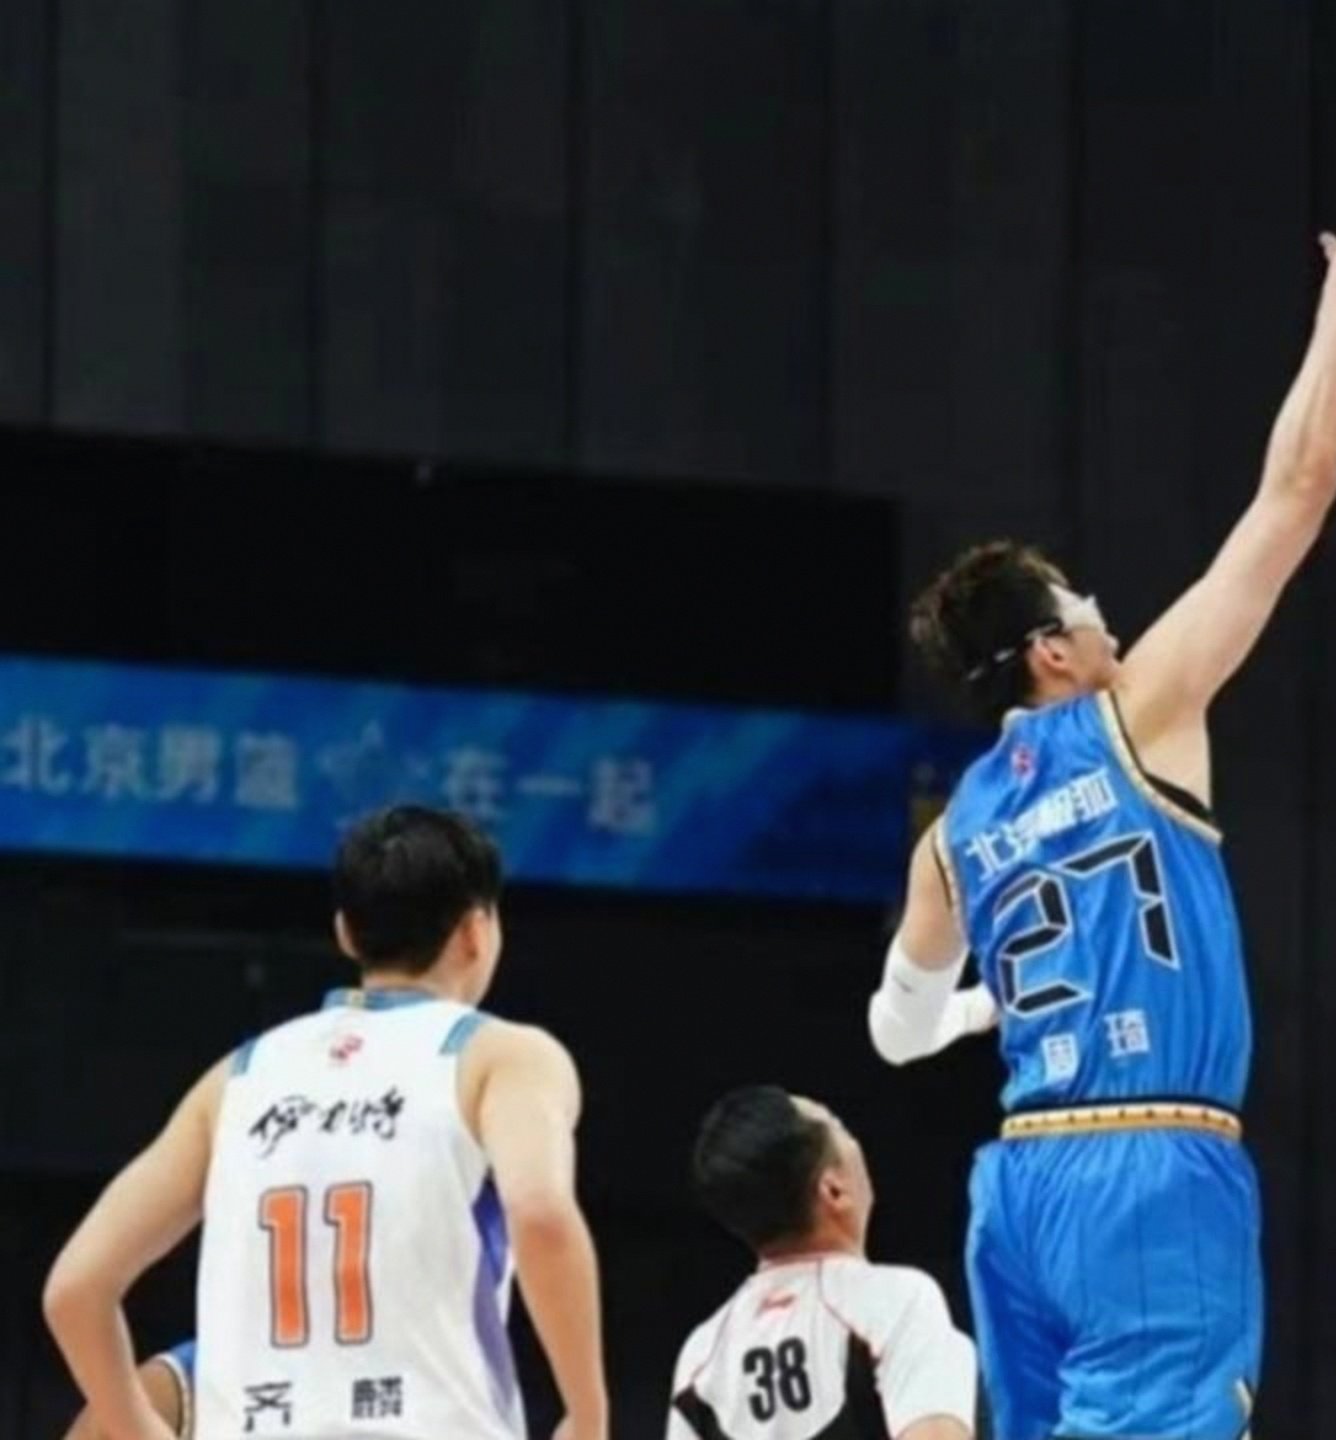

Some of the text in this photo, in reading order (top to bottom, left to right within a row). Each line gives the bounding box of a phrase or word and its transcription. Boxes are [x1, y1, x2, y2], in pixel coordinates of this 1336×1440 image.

[441, 747, 655, 834] 在一起
[992, 829, 1181, 1019] 27
[259, 1179, 374, 1349] 11
[743, 1336, 812, 1423] 38
